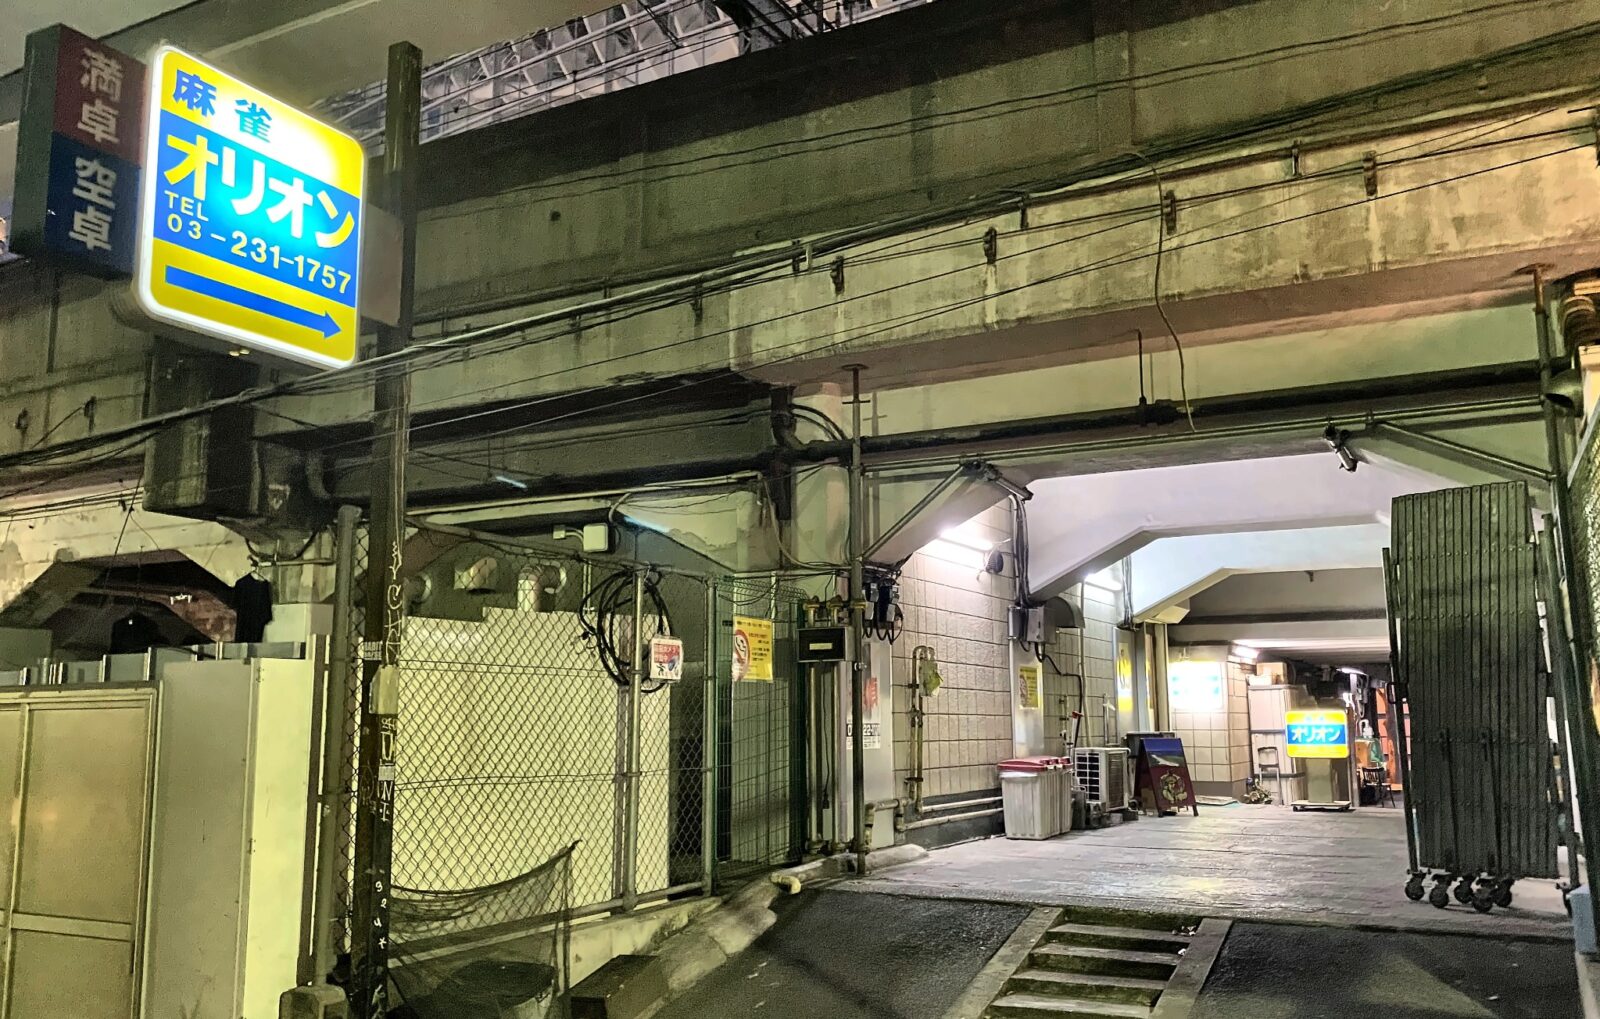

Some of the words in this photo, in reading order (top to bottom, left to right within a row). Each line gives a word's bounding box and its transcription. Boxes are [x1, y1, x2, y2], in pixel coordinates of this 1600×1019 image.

[173, 69, 272, 143] 麻雀
[68, 156, 117, 250] 空卓
[164, 134, 355, 248] オリオン
[164, 190, 209, 222] TEL
[1291, 726, 1341, 743] オリオン
